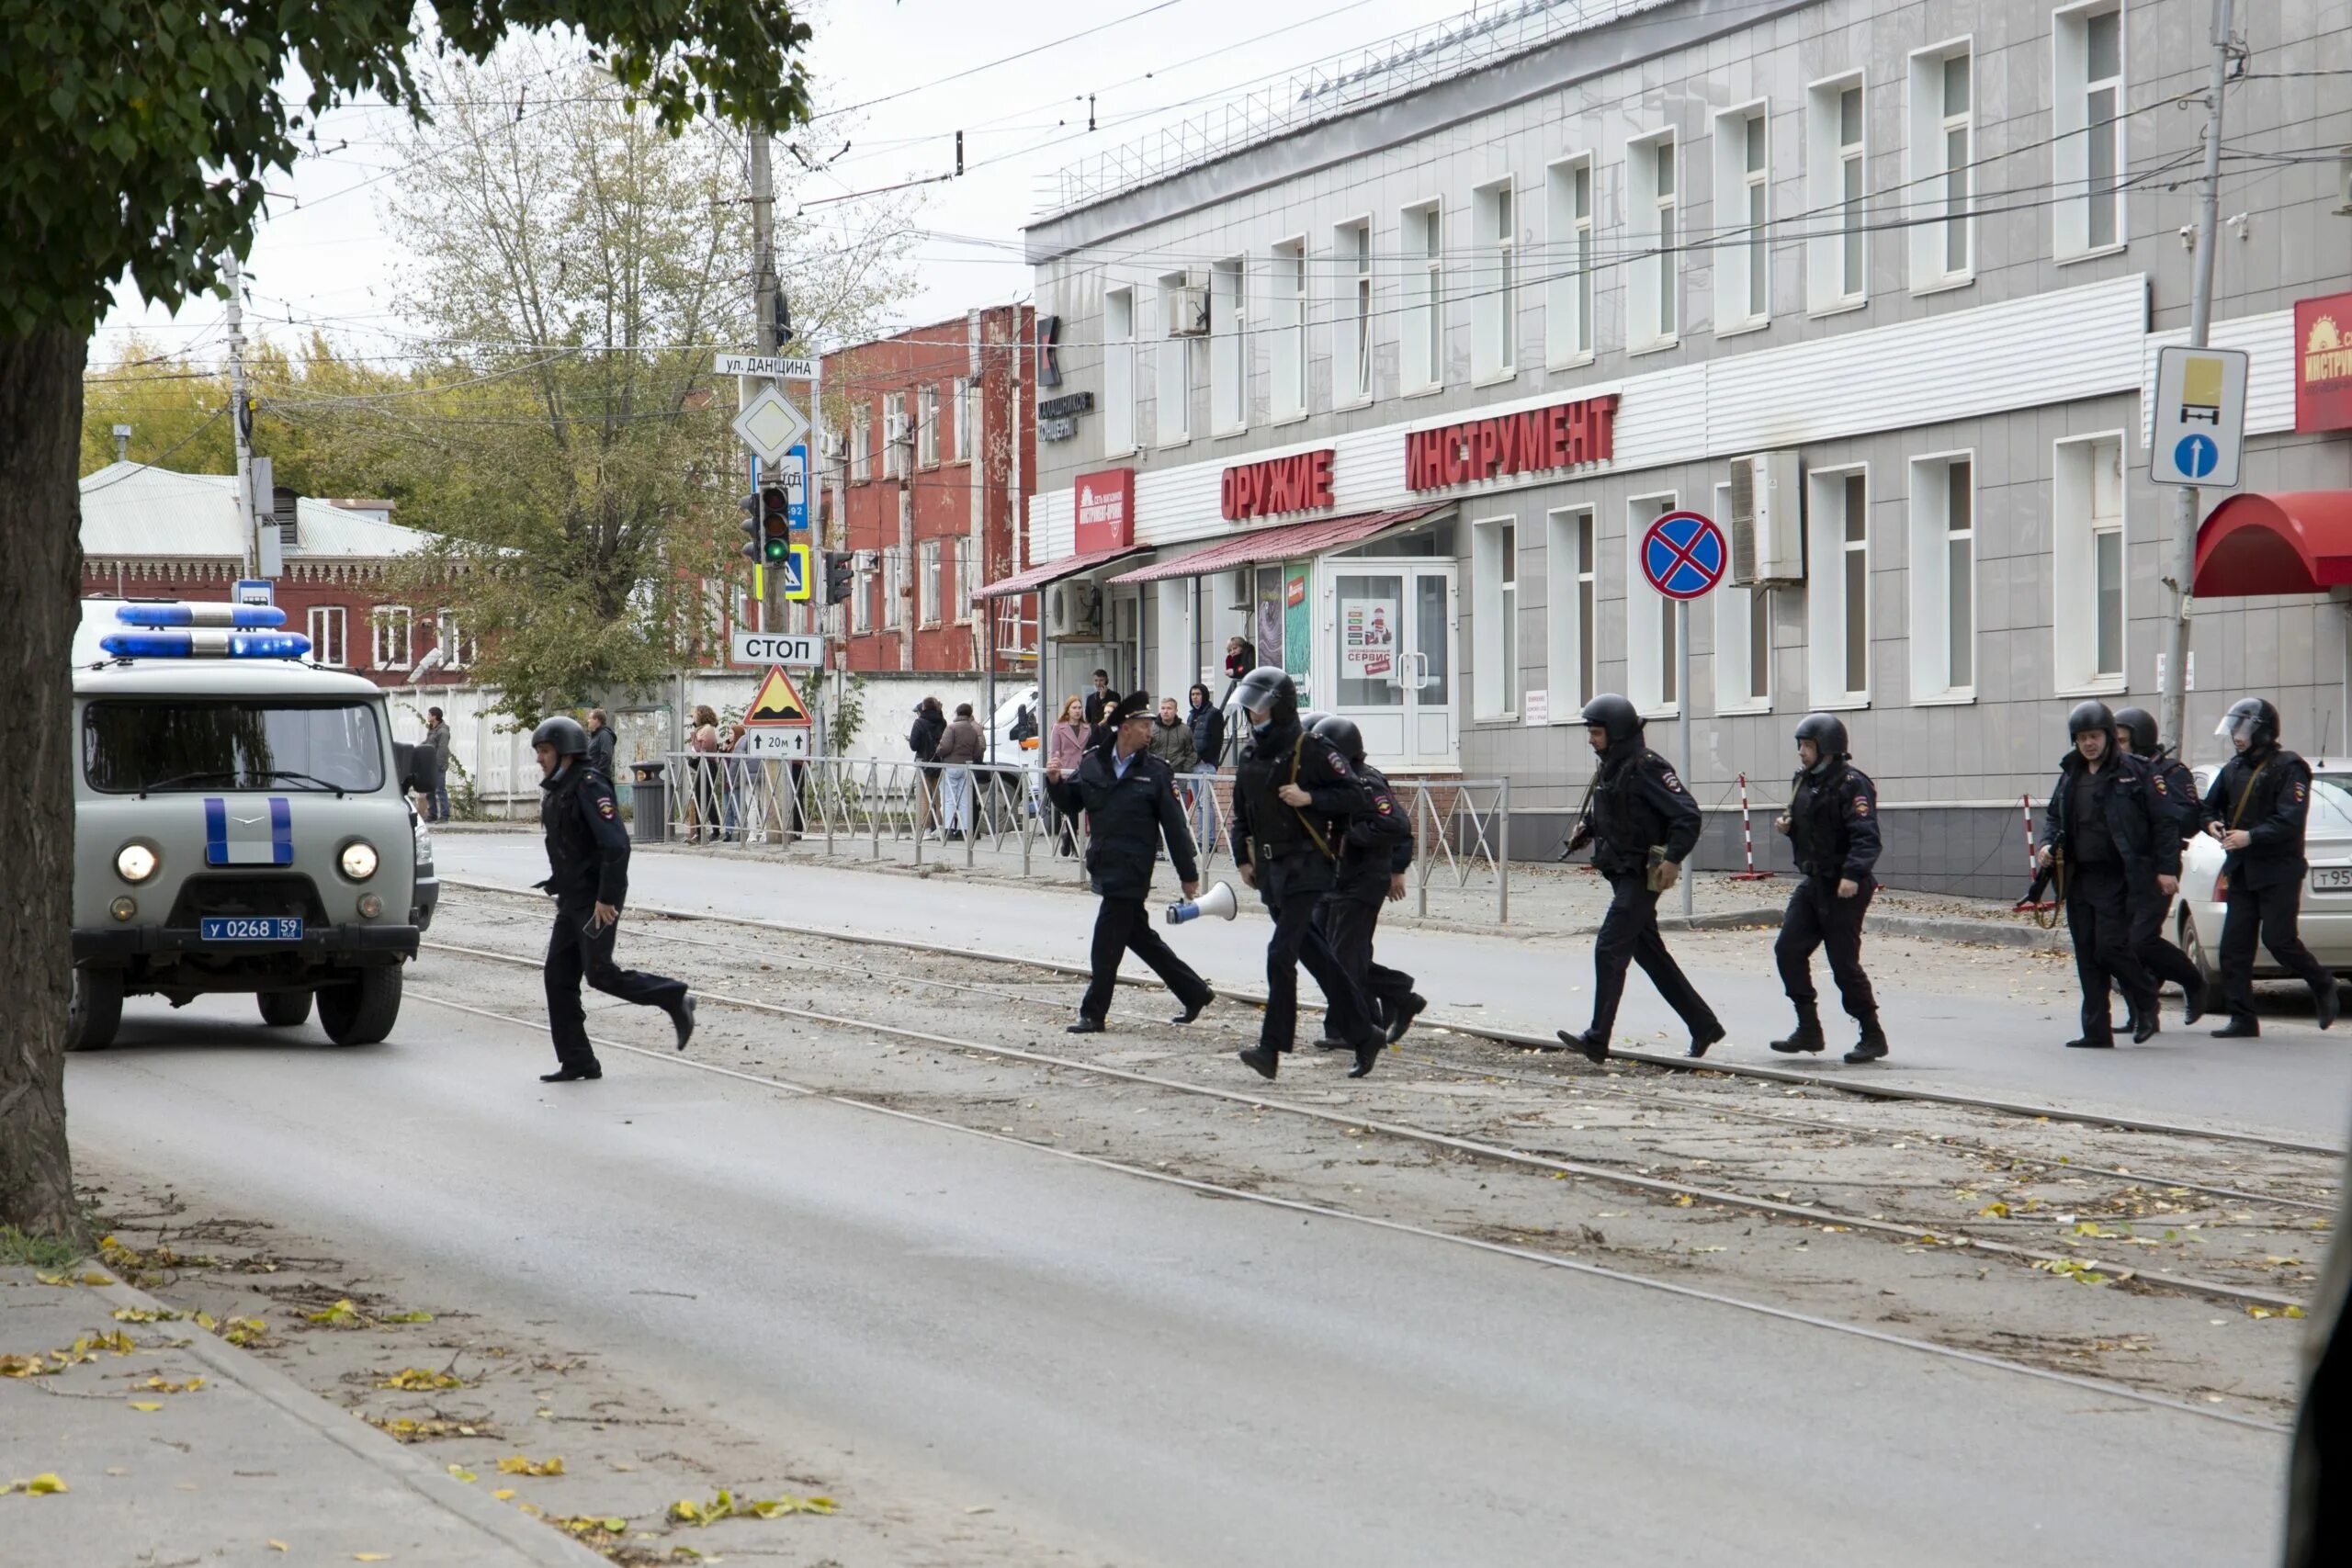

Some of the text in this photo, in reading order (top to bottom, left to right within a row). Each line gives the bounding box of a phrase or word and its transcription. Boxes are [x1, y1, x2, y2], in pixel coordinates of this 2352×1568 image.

[727, 357, 811, 376] ул. ДАНЩИНА
[1037, 418, 1072, 442] КОНЦЕРН
[1405, 393, 1618, 491] ИНСТРУМЕНТ
[1221, 448, 1334, 520] ОРУЖИЕ
[746, 639, 809, 660] СТОП
[1348, 653, 1391, 661] СЕРВИС
[226, 921, 270, 937] 0268
[280, 919, 297, 932] 59
